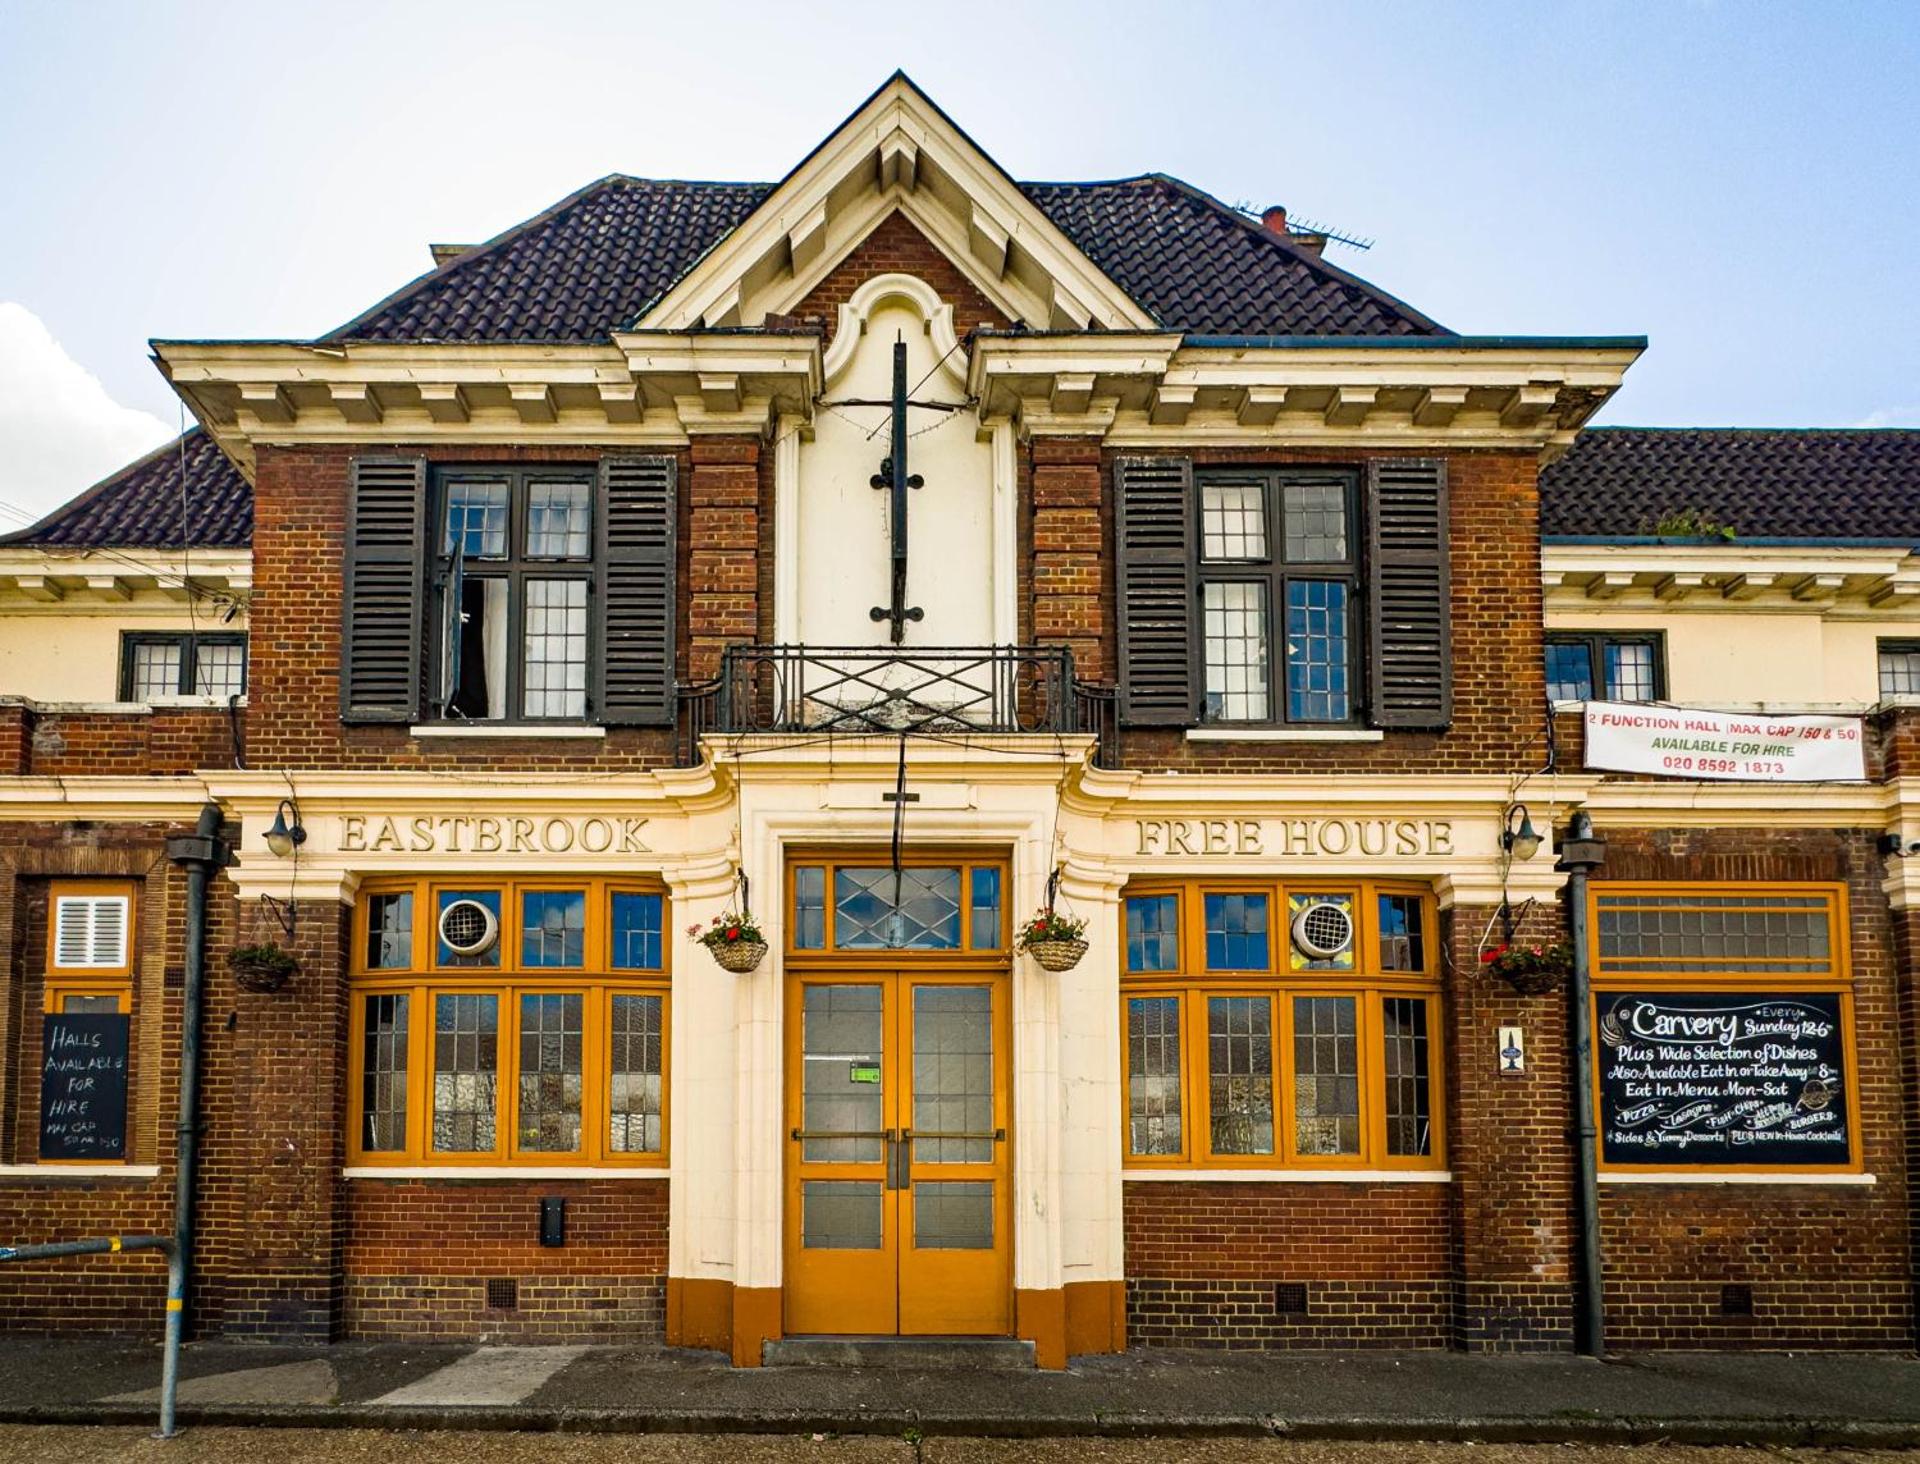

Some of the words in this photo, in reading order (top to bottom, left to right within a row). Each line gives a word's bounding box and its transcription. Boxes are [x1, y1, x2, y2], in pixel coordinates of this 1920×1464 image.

[1601, 714, 1679, 730] FUNCTION
[1685, 720, 1721, 732] HALL
[1767, 725, 1795, 738] CAP
[1798, 727, 1822, 739] 150
[1823, 728, 1832, 739] &
[1651, 737, 1728, 753] AVAILABLE
[1732, 742, 1761, 756] FOR
[1762, 744, 1795, 757] HIRE
[1663, 756, 1692, 769] 020
[1697, 758, 1737, 773] 8592
[1744, 762, 1784, 774] 1873
[337, 815, 652, 852] EASTBROOK
[1136, 818, 1264, 855] FREE
[1281, 818, 1455, 856] HOUSE
[1762, 1006, 1800, 1021] Every
[1632, 1003, 1737, 1046] Carvery
[1744, 1018, 1800, 1040] Sunday
[1617, 1045, 1654, 1061] Plus
[1657, 1046, 1691, 1060] Wide
[1693, 1045, 1751, 1060] Selection
[1754, 1043, 1771, 1064] of
[1769, 1044, 1818, 1060] Dishes
[45, 1056, 123, 1072] AVAILABLE
[1607, 1064, 1638, 1079] Also
[1638, 1063, 1699, 1079] Available
[1700, 1064, 1725, 1078] Eat
[1725, 1064, 1738, 1077] In
[1739, 1067, 1752, 1077] or
[1750, 1063, 1779, 1077] Take
[1780, 1063, 1807, 1081] Away
[68, 1077, 95, 1093] FOR
[1625, 1082, 1652, 1096] Eat
[1656, 1082, 1672, 1096] In
[1672, 1082, 1720, 1097] Menu
[1722, 1081, 1788, 1097] Mon-Sat
[49, 1099, 89, 1117] HIRE
[1615, 1131, 1644, 1144] Sides
[1654, 1129, 1687, 1149] Yummy
[1684, 1130, 1725, 1142] Desserts
